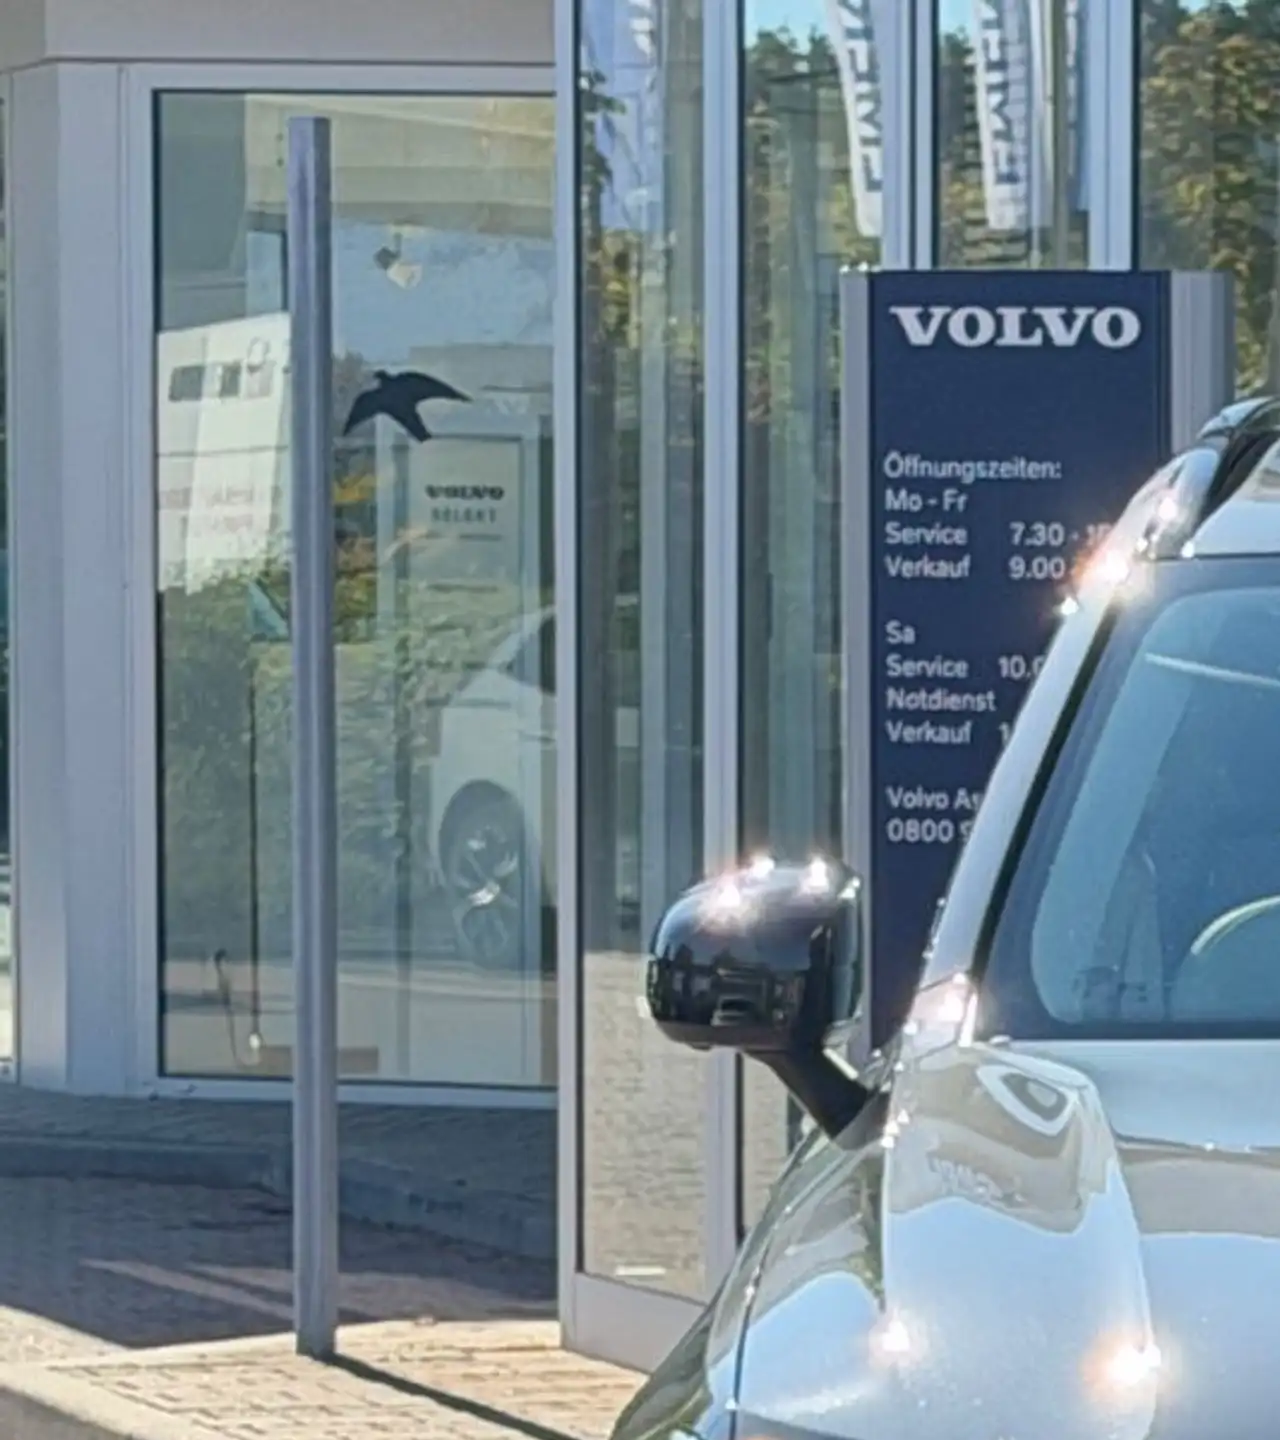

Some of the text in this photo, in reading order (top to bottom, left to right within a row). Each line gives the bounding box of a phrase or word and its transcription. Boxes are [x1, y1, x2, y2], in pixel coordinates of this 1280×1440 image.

[889, 306, 1141, 348] VOLVO
[883, 451, 1062, 485] Öffnungszeiten:
[885, 488, 923, 512] Mo
[943, 488, 968, 512] Fr
[884, 521, 968, 546] Service
[1010, 522, 1065, 547] 7.30
[885, 554, 1066, 580] Verkauf 9.00
[885, 620, 916, 645] Sa
[885, 653, 969, 678] Service
[886, 687, 997, 712] Notdienst
[885, 720, 972, 745] Verkauf
[886, 785, 950, 810] Volvo
[887, 818, 955, 844] 0800
